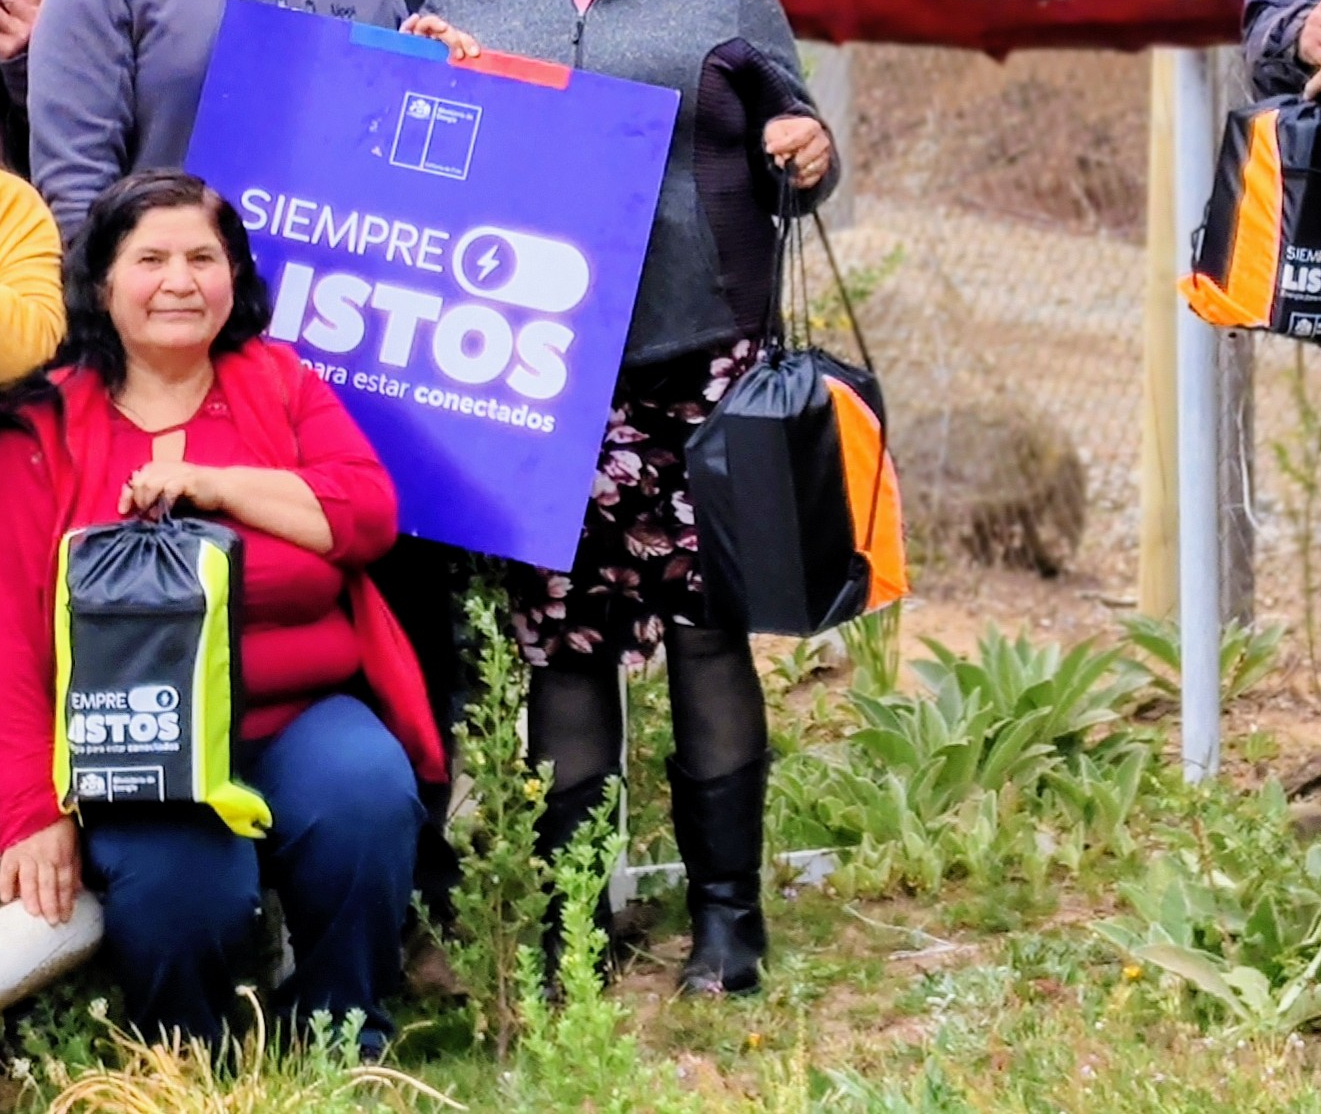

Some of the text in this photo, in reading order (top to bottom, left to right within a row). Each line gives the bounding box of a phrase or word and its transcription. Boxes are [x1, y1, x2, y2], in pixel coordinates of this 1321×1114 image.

[240, 189, 450, 273] SIEMPRE
[266, 262, 575, 400] ISTOS
[353, 370, 411, 399] estar
[414, 385, 556, 434] conectados
